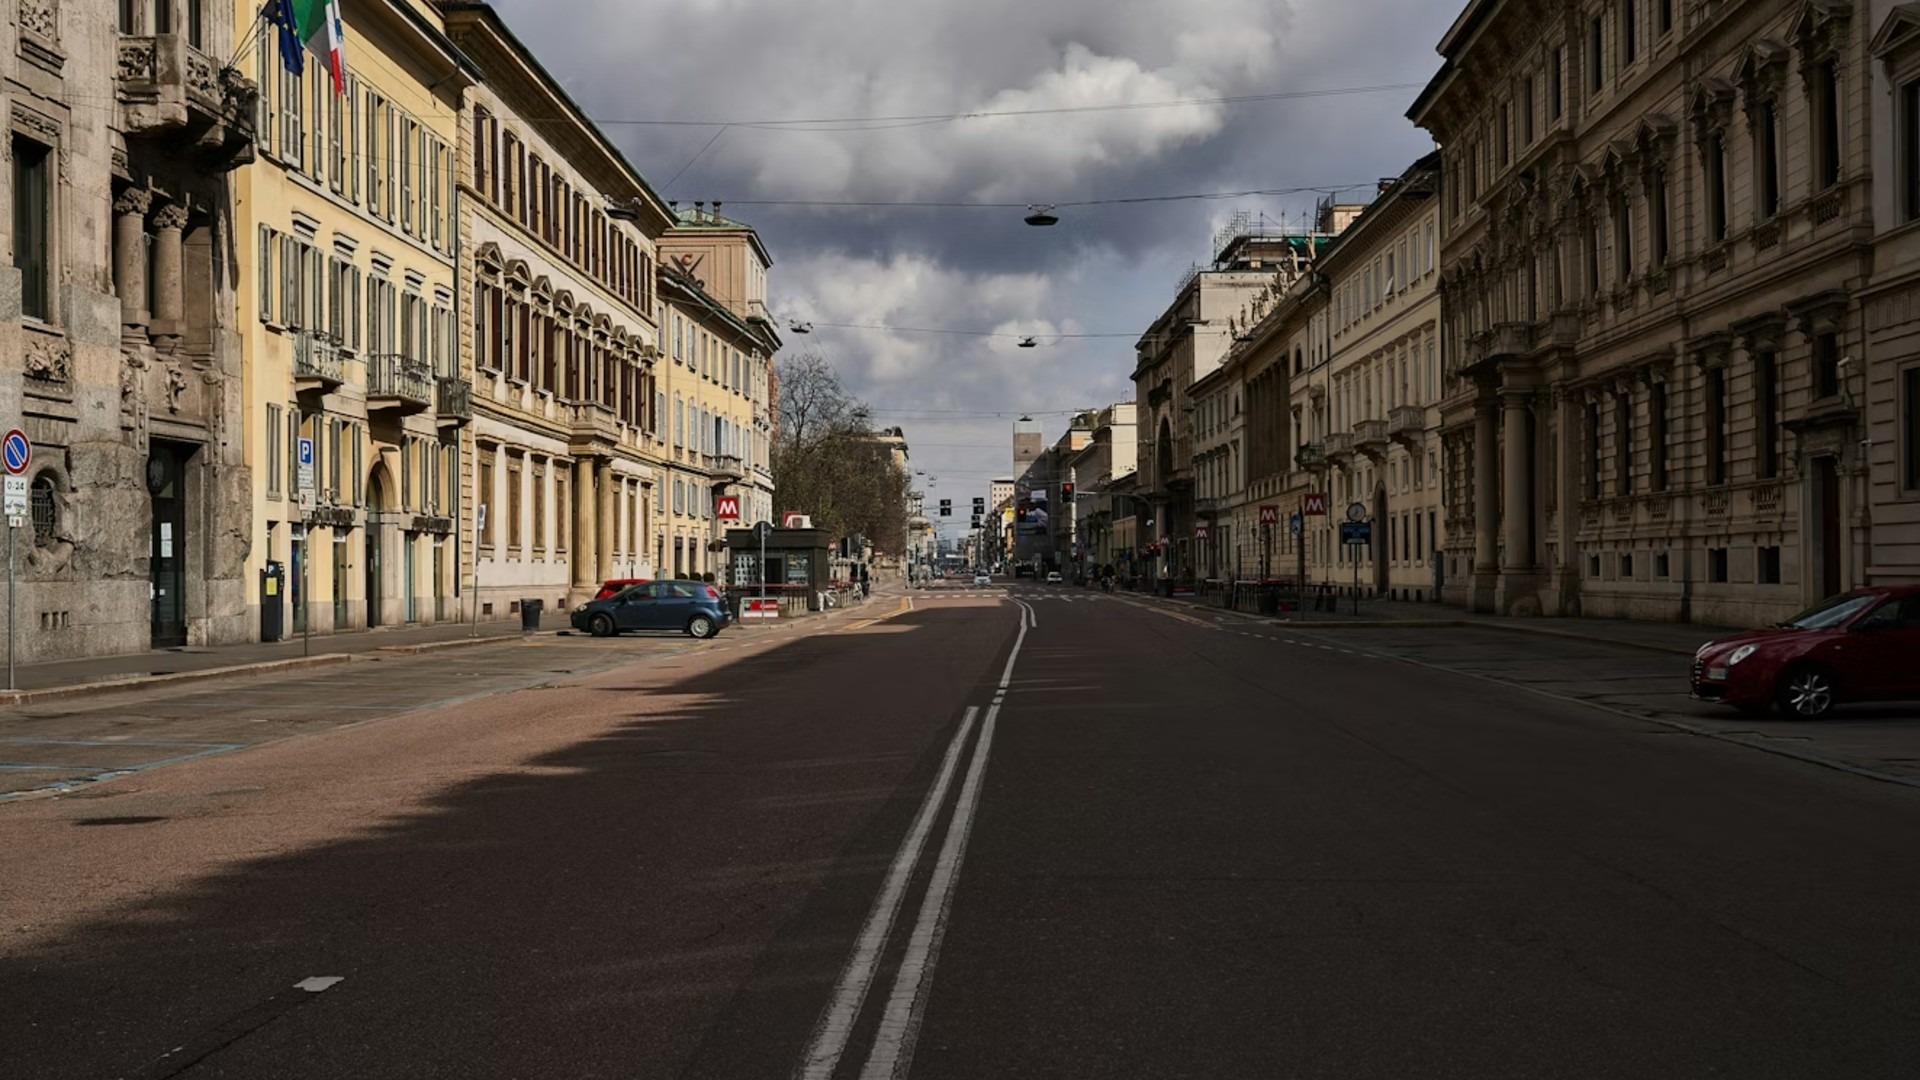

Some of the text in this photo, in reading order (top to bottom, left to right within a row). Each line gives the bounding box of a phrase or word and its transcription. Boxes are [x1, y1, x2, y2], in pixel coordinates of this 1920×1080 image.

[302, 442, 310, 461] P
[719, 501, 738, 515] M
[1306, 498, 1323, 512] M
[1261, 509, 1276, 521] M
[1196, 529, 1208, 538] M
[1160, 537, 1169, 545] M
[268, 564, 275, 574] P
